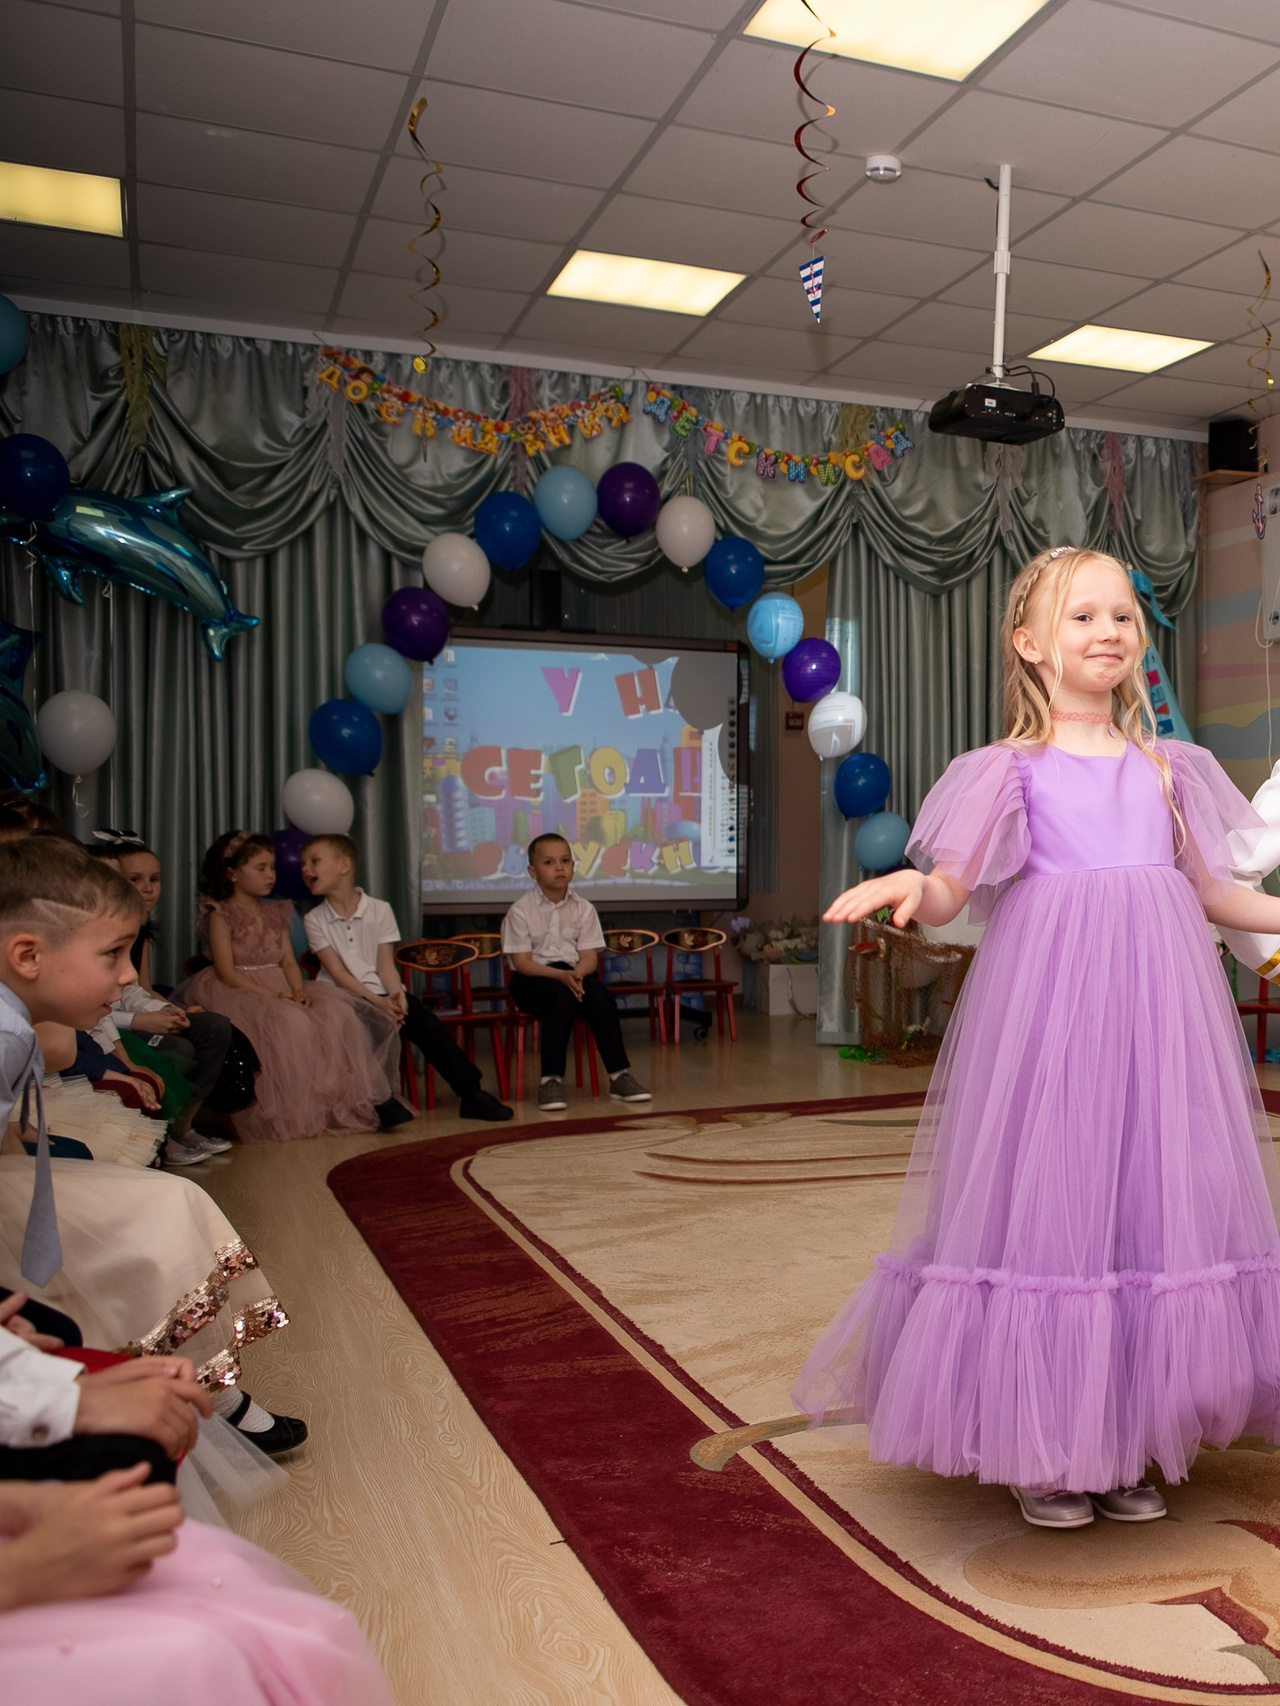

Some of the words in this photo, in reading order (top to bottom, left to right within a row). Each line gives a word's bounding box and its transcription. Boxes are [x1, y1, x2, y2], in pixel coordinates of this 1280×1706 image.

[317, 363, 370, 403] ДО
[642, 394, 839, 487] ДЕТСКИЙ
[842, 428, 915, 480] САД
[541, 667, 582, 716] У
[614, 667, 679, 718] Н
